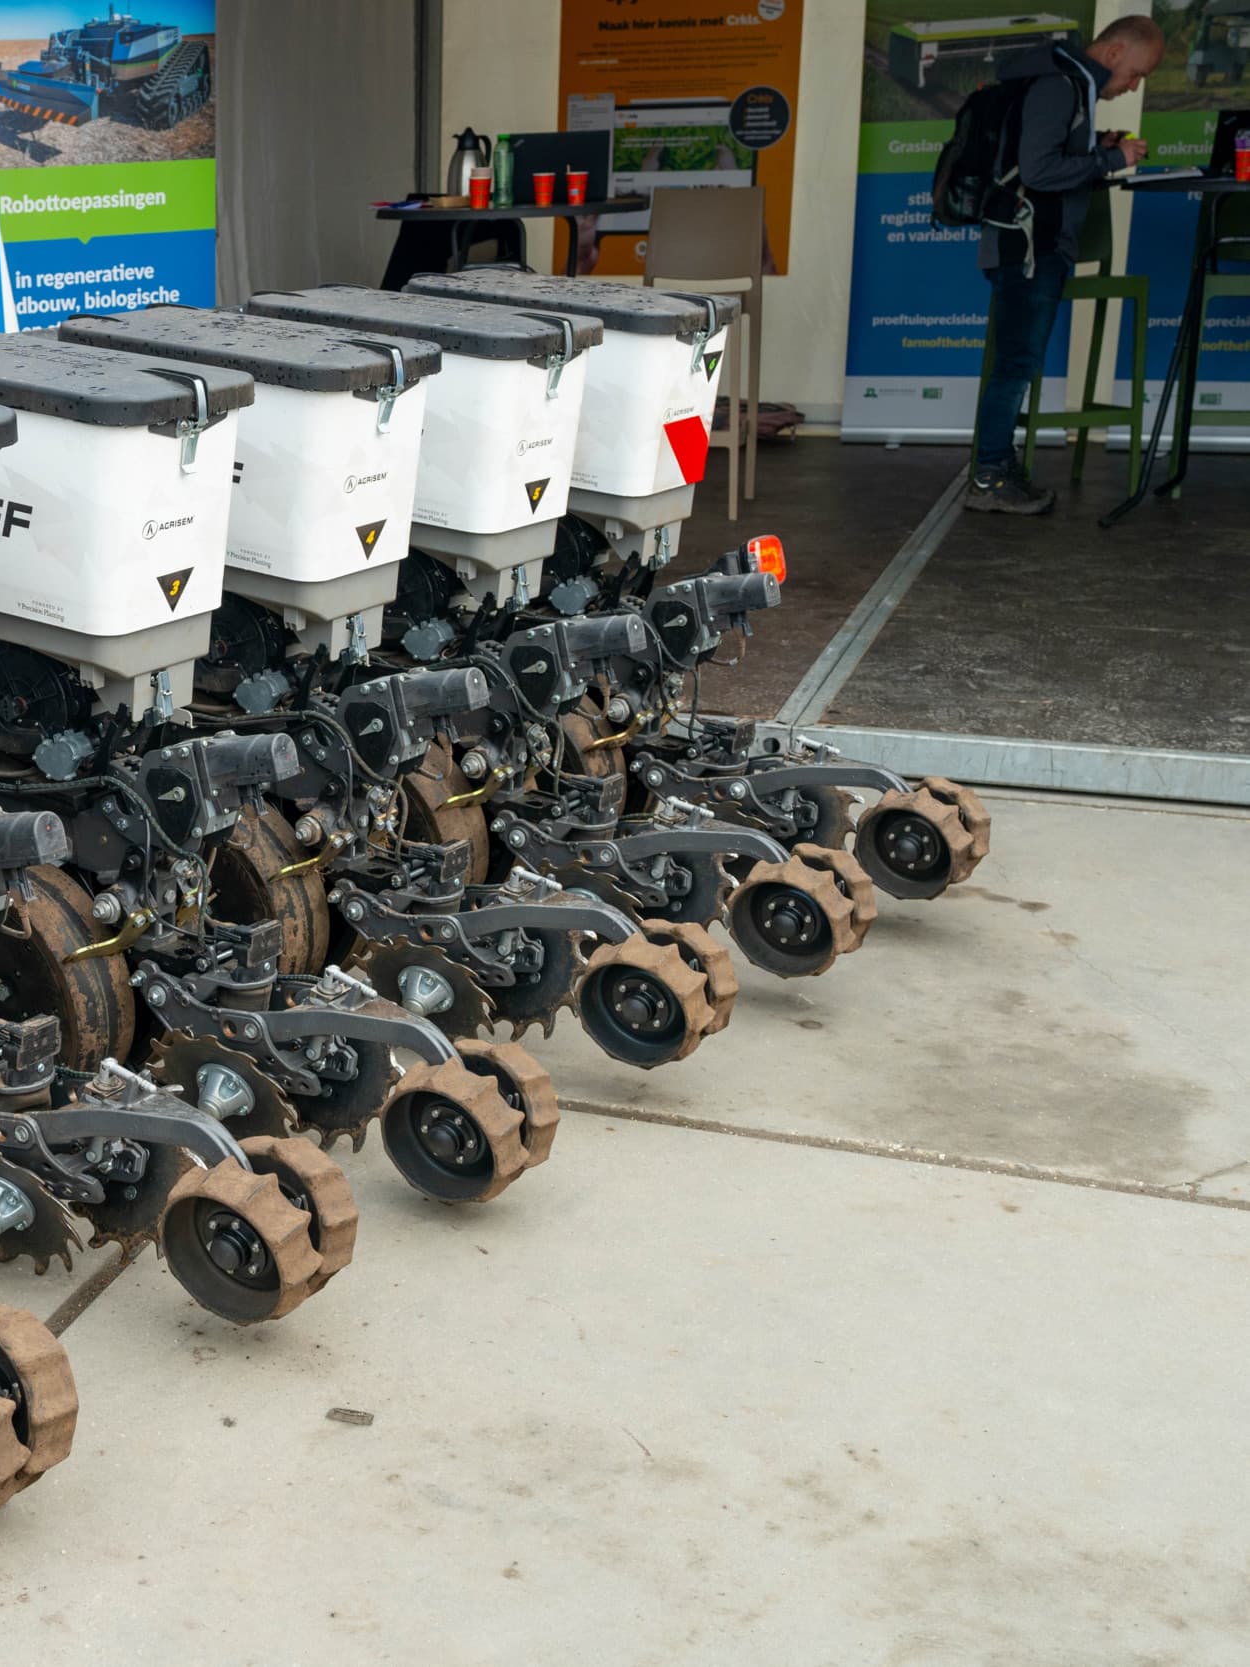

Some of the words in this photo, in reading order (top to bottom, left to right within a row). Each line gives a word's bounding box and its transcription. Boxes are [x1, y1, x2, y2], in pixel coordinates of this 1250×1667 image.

[598, 20, 629, 31] Maak
[632, 18, 655, 29] hier
[657, 17, 697, 29] kennis
[700, 15, 724, 27] met
[887, 138, 944, 153] Graslan
[1158, 140, 1214, 155] onkrui
[0, 188, 167, 215] Robottoepassingen
[887, 233, 905, 243] en
[908, 228, 965, 243] variabel
[36, 262, 156, 289] regeneratieve
[14, 293, 82, 315] dbouw,
[84, 285, 181, 309] biologische
[872, 313, 989, 327] proeftuinprecisielan
[901, 336, 987, 349] farmofthefutu
[708, 358, 717, 370] 6
[358, 472, 387, 486] AGRISEM
[532, 487, 542, 501] 5
[159, 516, 194, 532] AGRISEM
[366, 529, 377, 545] 4
[169, 580, 181, 597] 3
